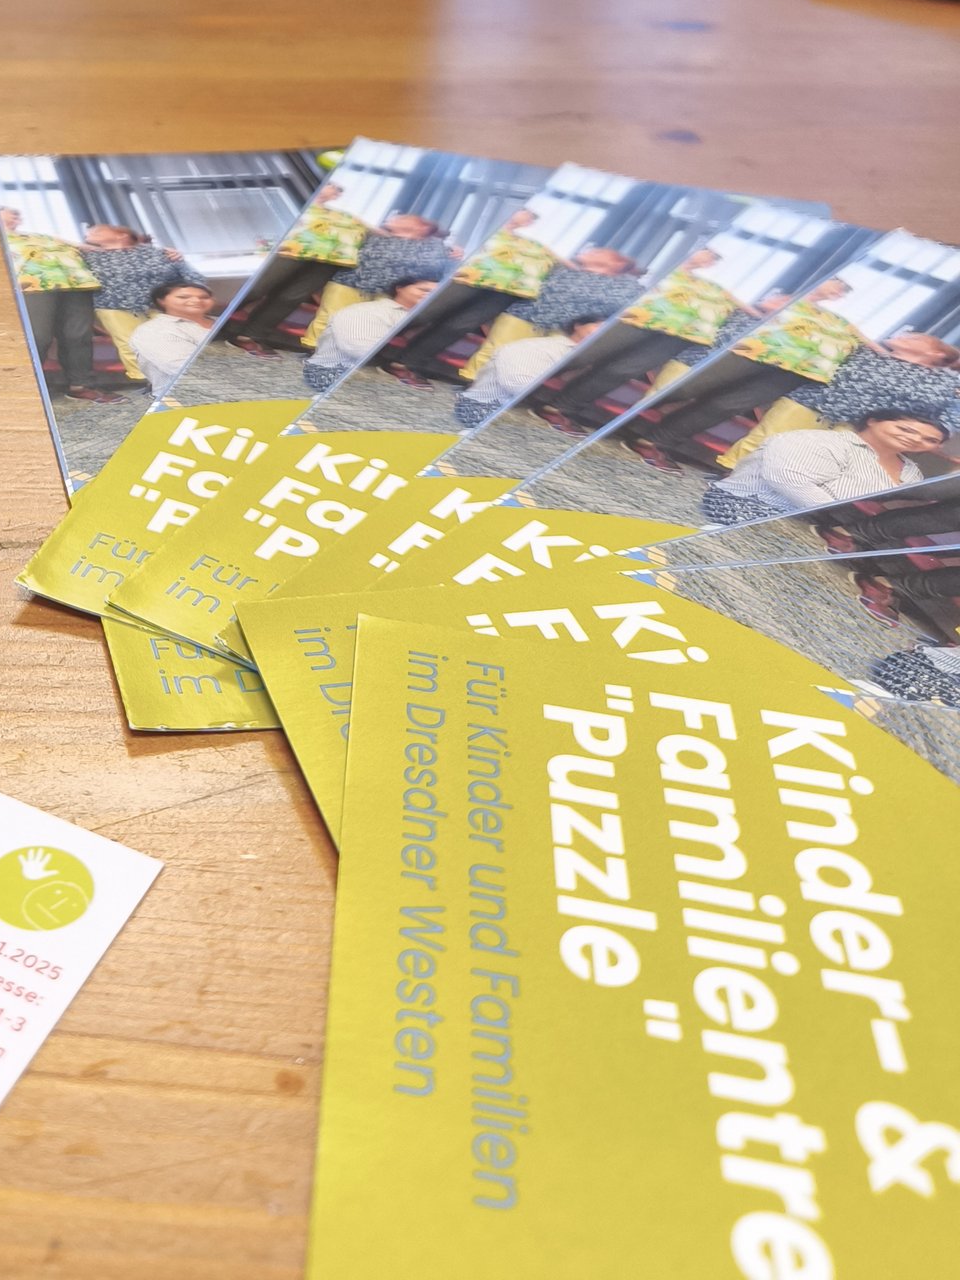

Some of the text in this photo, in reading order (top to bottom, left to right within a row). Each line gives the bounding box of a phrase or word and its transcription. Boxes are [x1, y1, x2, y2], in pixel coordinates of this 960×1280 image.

[259, 476, 368, 535] Fa
[70, 555, 124, 587] im
[165, 577, 221, 614] im
[190, 554, 258, 591] Für
[294, 627, 337, 671] im
[159, 669, 222, 694] im
[466, 660, 505, 712] Für
[466, 722, 514, 852] Kinder
[393, 649, 449, 1098] im Dresdner Westen
[468, 864, 519, 957] und
[760, 709, 960, 1198] Kinder- &
[471, 966, 531, 1211] Familien
